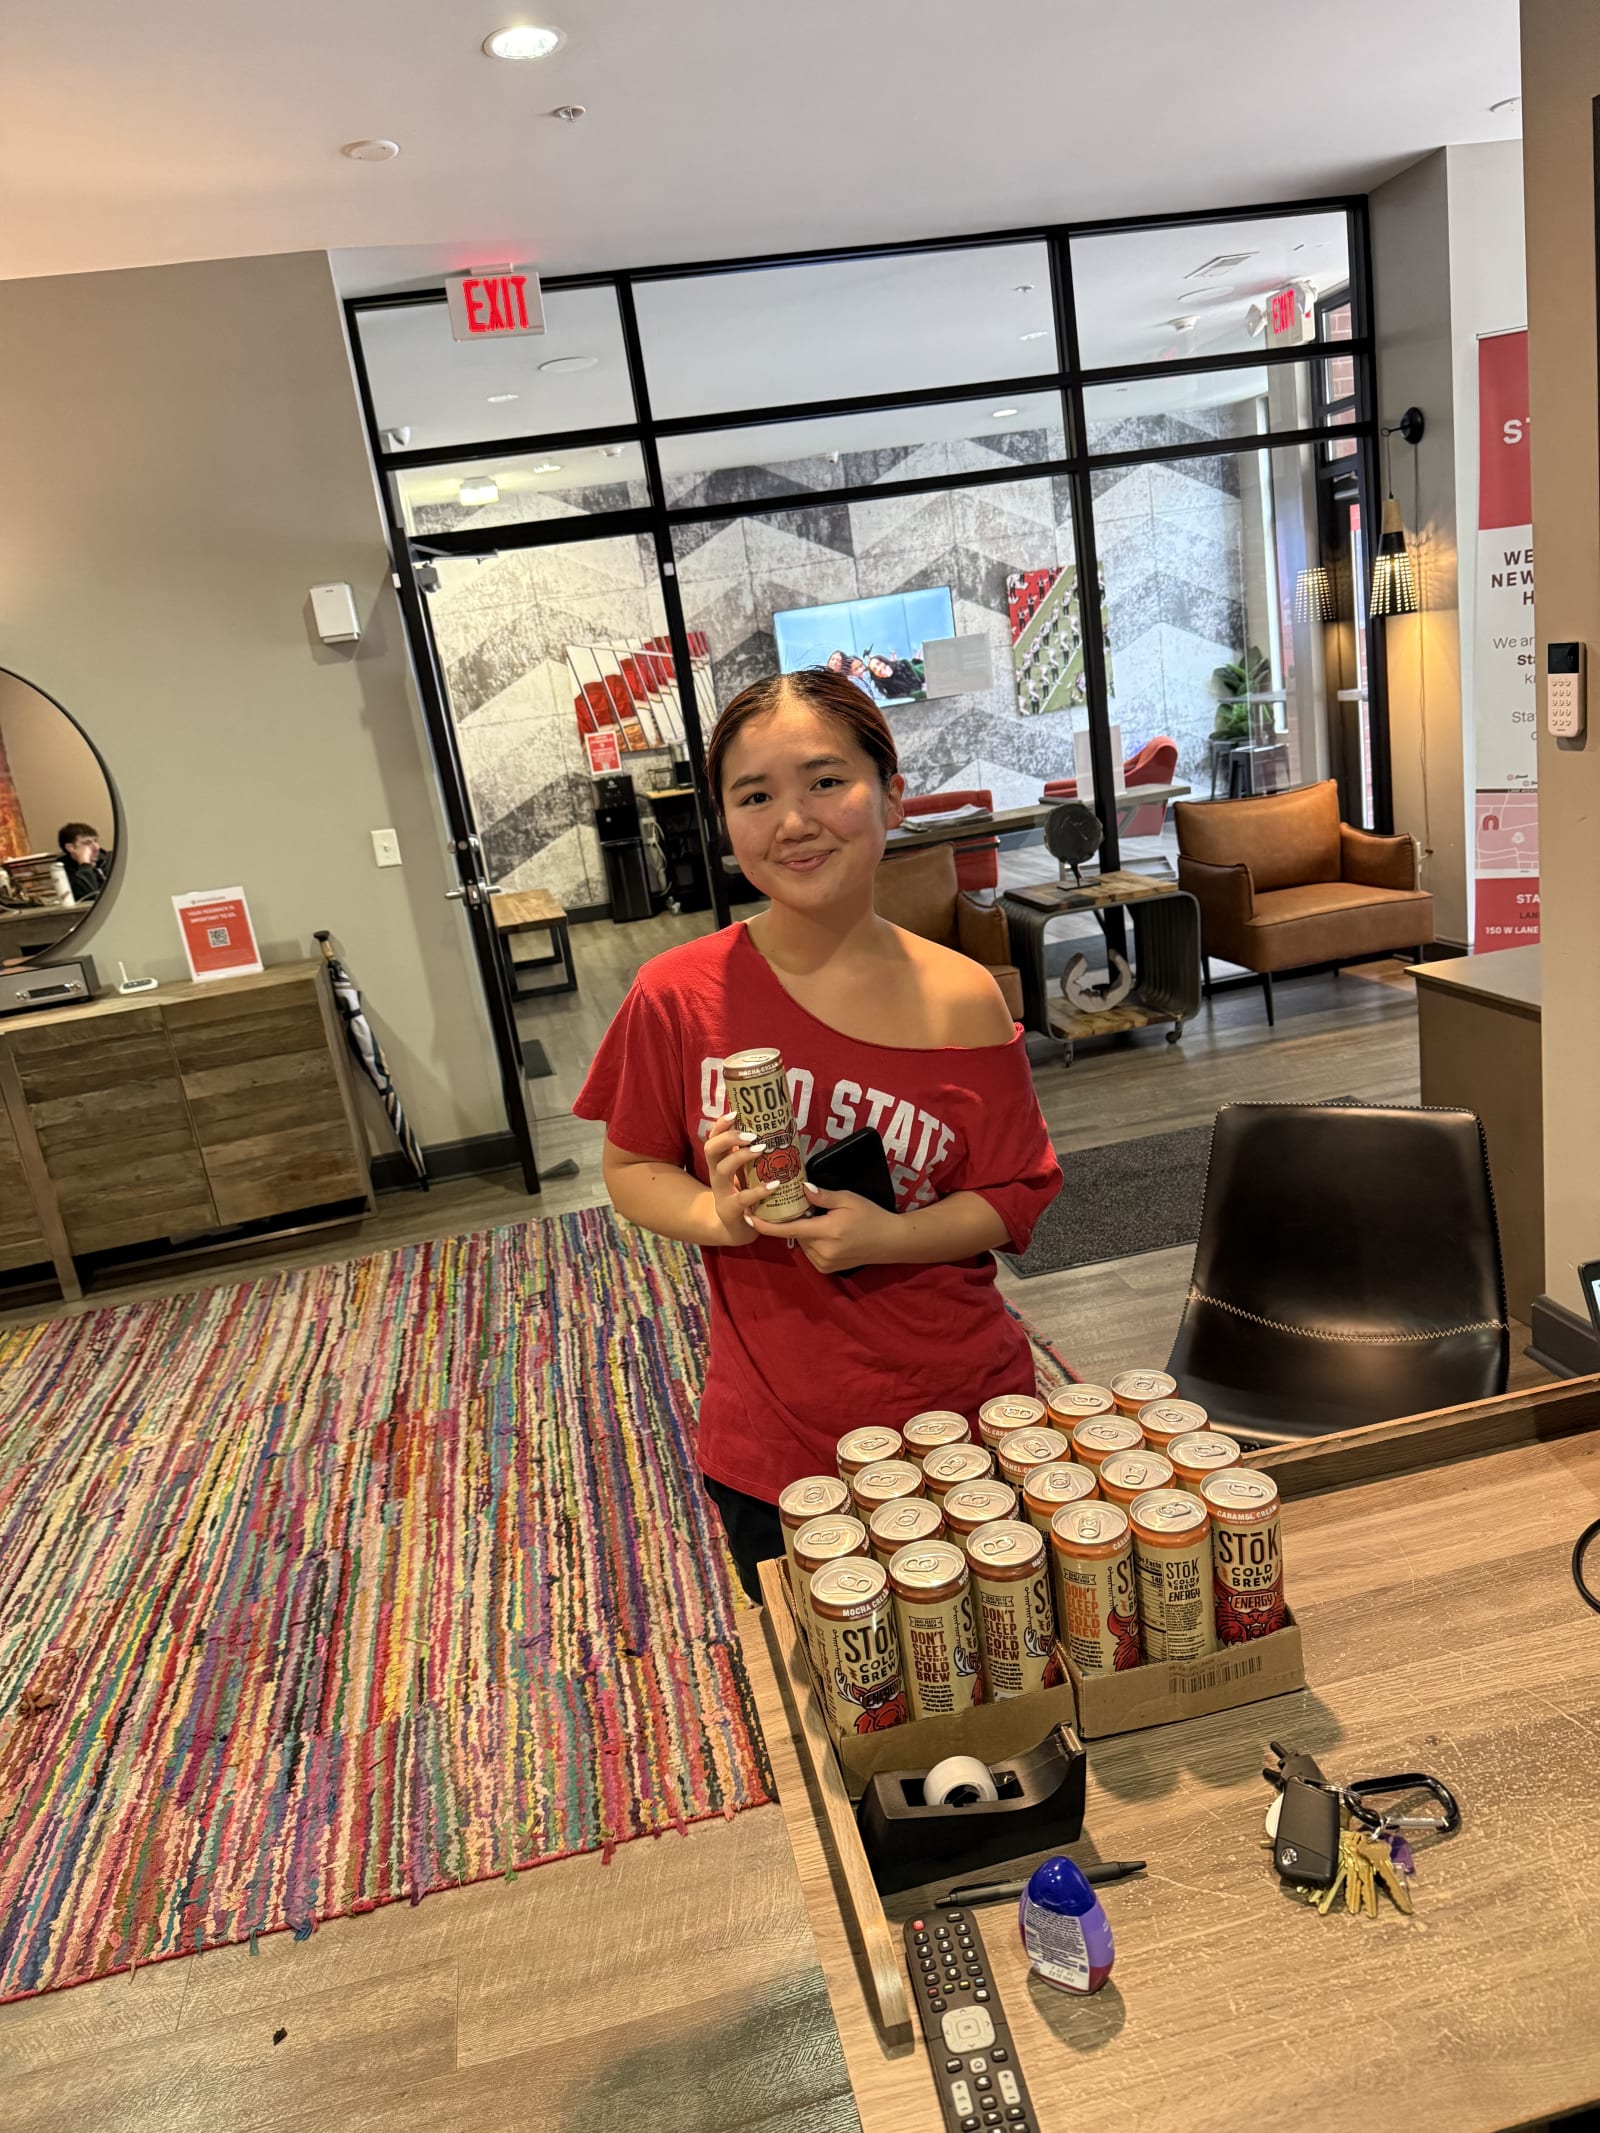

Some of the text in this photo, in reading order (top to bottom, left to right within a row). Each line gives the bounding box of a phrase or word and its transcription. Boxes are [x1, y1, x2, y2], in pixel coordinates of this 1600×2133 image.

[463, 276, 529, 333] EXIT
[1271, 288, 1296, 334] EXIT
[1493, 637, 1517, 649] We
[1485, 926, 1502, 935] 150
[1503, 926, 1513, 934] W
[753, 1109, 785, 1123] COLD
[755, 1117, 787, 1132] BREW
[825, 1079, 956, 1174] STATE
[1216, 1510, 1256, 1521] CARAMEL
[1231, 1564, 1273, 1577] COLD
[1232, 1574, 1273, 1588] BREW
[1064, 1581, 1097, 1601] DON'T
[1168, 1587, 1201, 1602] ENERGY
[1066, 1595, 1098, 1613] SLEEP
[1234, 1593, 1273, 1609] ENERGY
[842, 1606, 871, 1617] MOCHA
[982, 1605, 1015, 1622] DON'T
[984, 1619, 1017, 1636] SLEEP
[1068, 1612, 1100, 1628] COLD
[910, 1629, 945, 1646] DON'T
[1068, 1622, 1100, 1638] BREW
[912, 1643, 947, 1658] SLEEP
[985, 1635, 1020, 1651] COLD
[987, 1646, 1020, 1660] BREW
[859, 1649, 895, 1674] COLD
[914, 1660, 950, 1673] COLD
[861, 1659, 896, 1684] BREW
[916, 1670, 950, 1682] BREW
